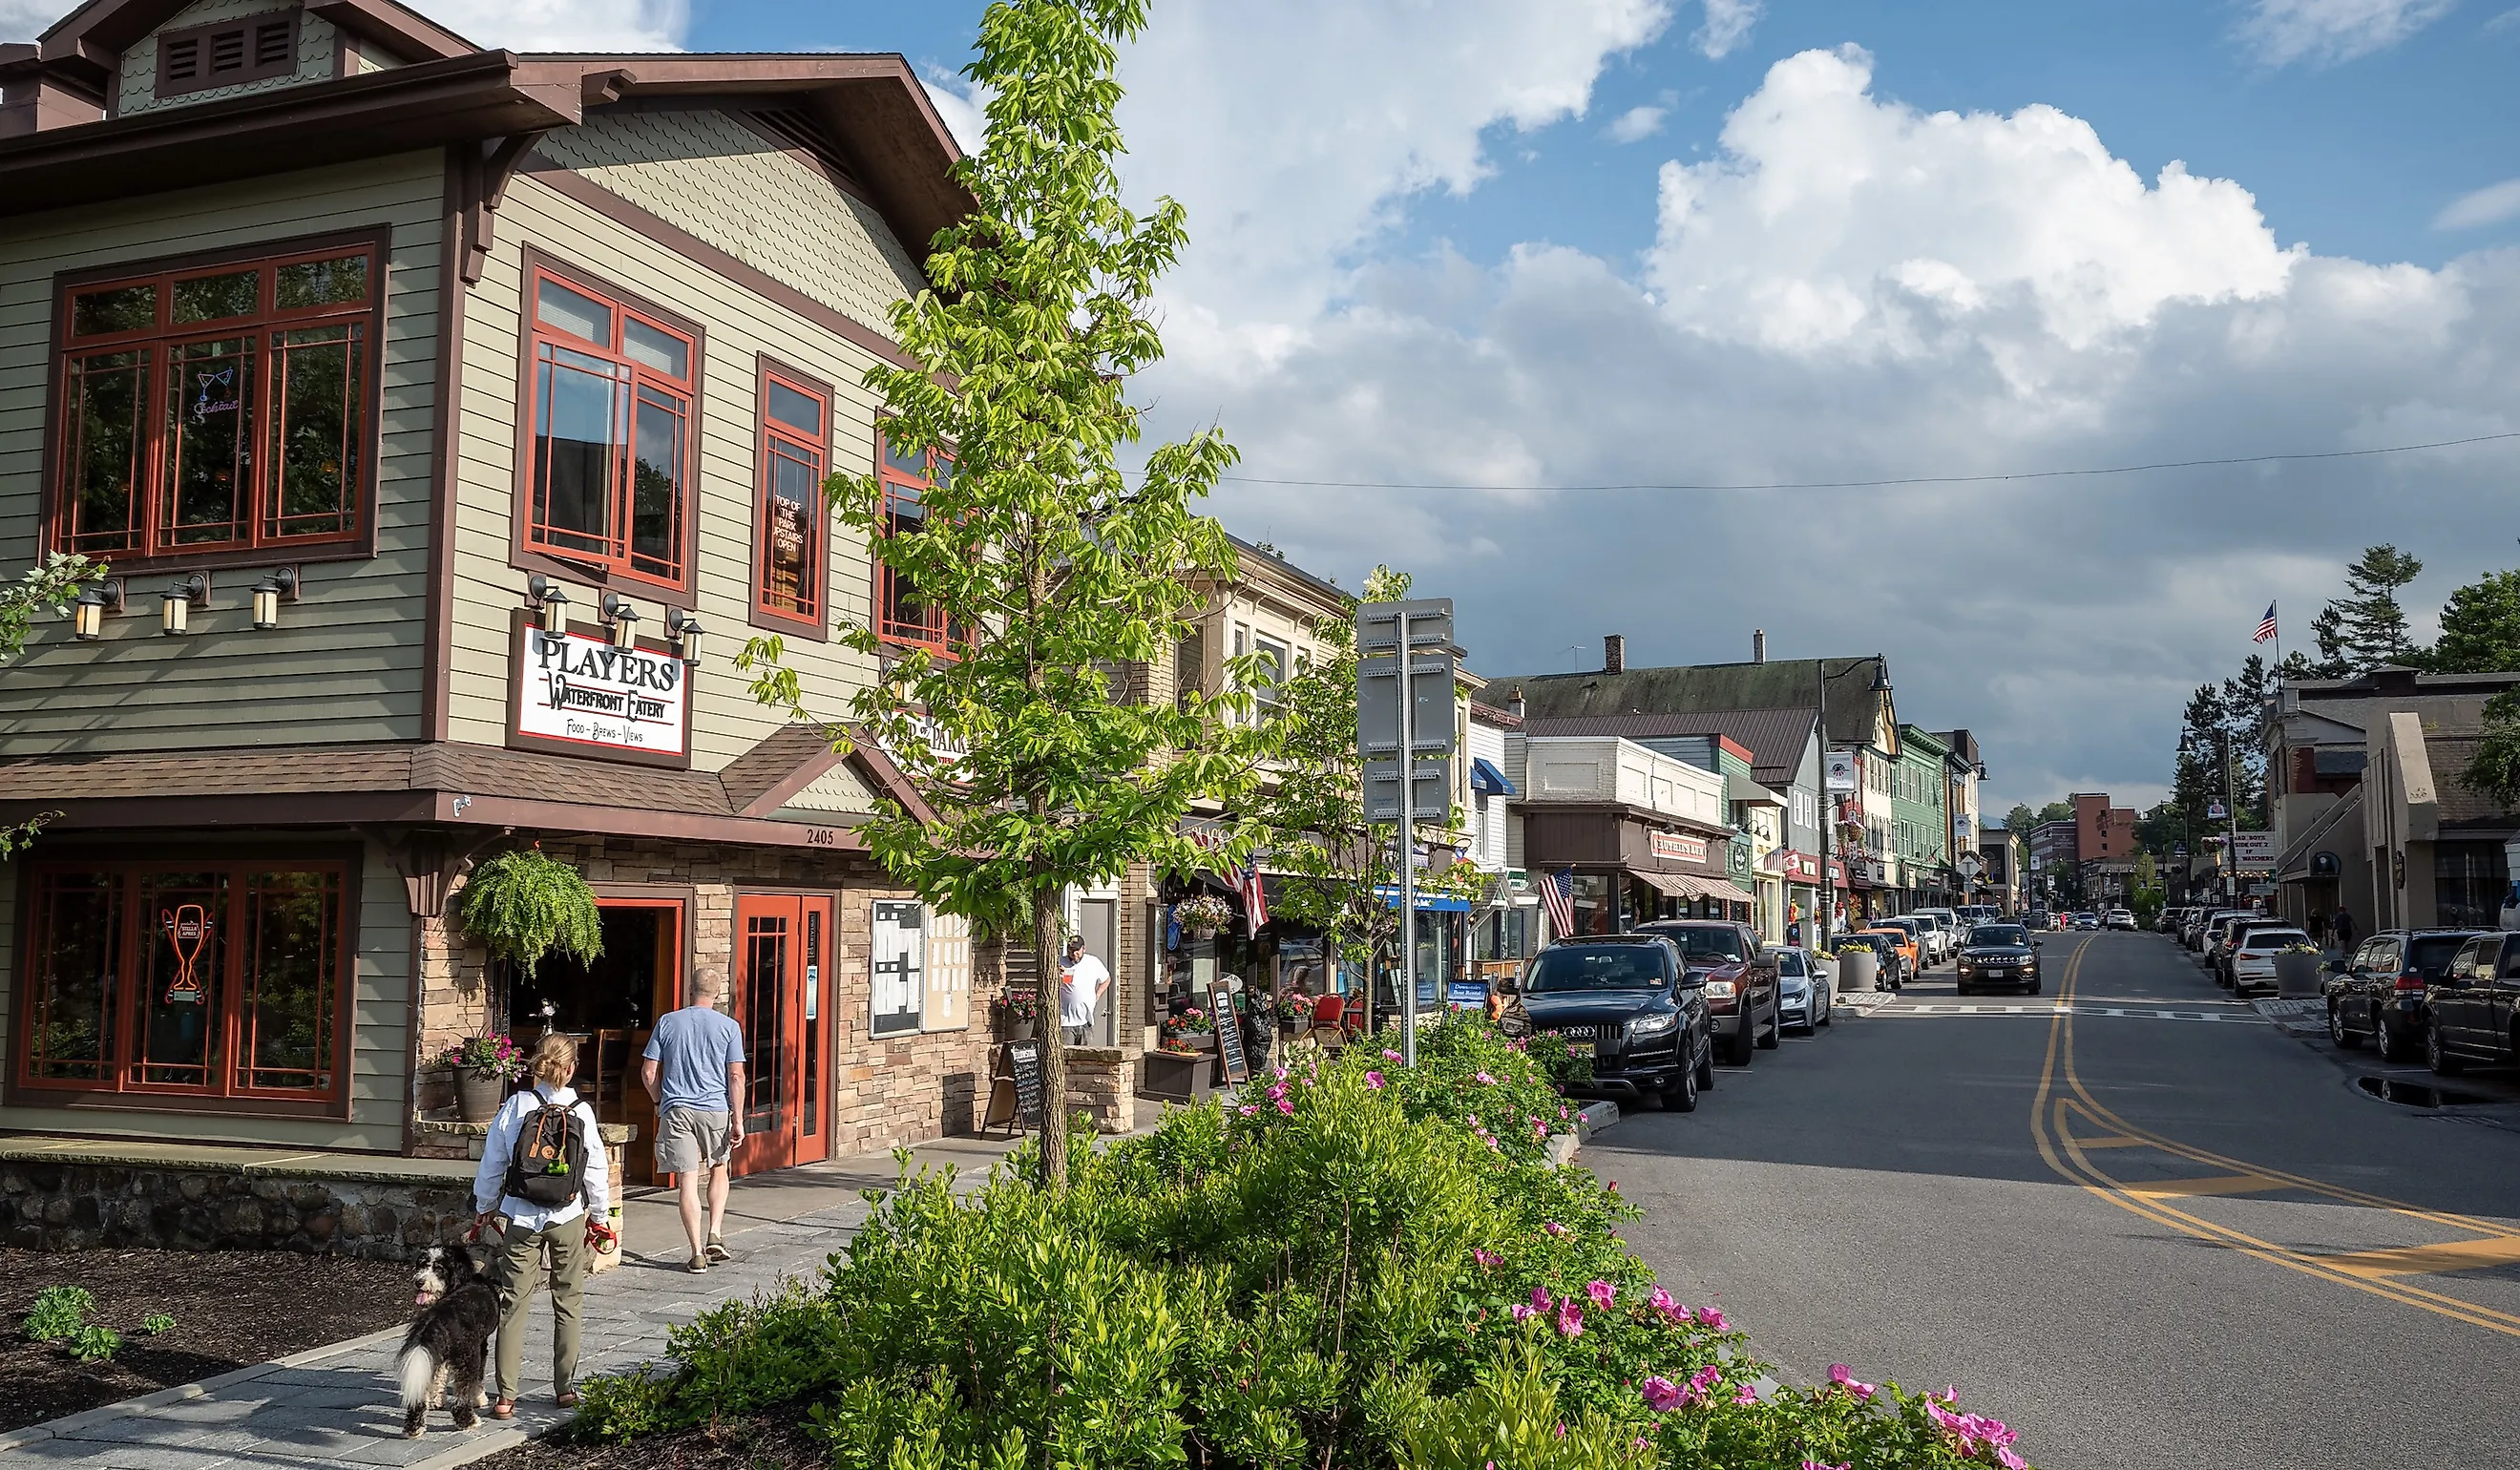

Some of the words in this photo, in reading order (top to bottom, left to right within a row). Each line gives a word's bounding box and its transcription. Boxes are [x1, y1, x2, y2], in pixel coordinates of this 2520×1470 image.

[776, 494, 790, 508] TOP
[790, 501, 801, 512] OF
[781, 508, 795, 521] THE
[779, 517, 796, 532] PARK
[777, 537, 796, 553] OPEN
[538, 638, 675, 691] PLAYERS
[547, 671, 624, 712] WATERFRONT
[626, 690, 665, 722] EATERY
[807, 830, 833, 845] 2405
